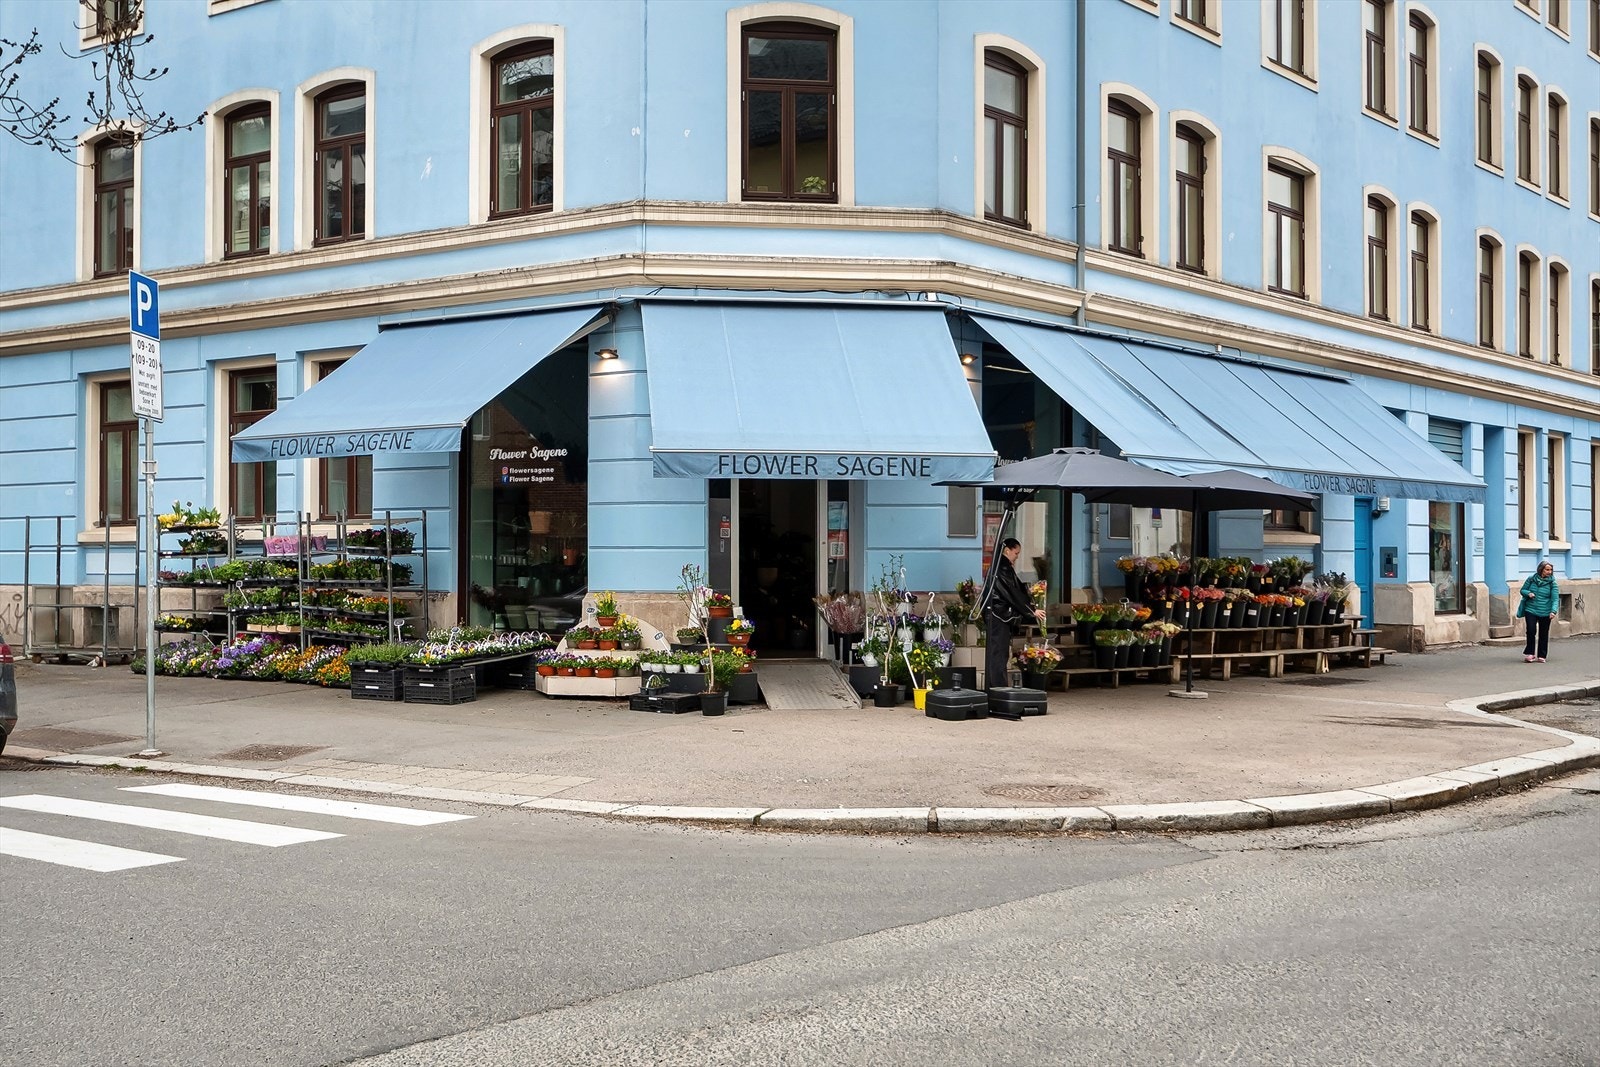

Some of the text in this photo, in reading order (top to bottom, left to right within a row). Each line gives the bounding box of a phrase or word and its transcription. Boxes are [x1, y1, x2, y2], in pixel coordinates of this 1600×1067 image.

[136, 281, 152, 327] P
[135, 353, 158, 370] (09-20)
[270, 431, 415, 458] FLOWER SAGENE
[489, 446, 568, 461] Flower Sagene
[717, 454, 932, 477] FLOWER SAGENE
[531, 475, 554, 483] Sagene
[1303, 474, 1377, 494] FLOWER SAGENE
